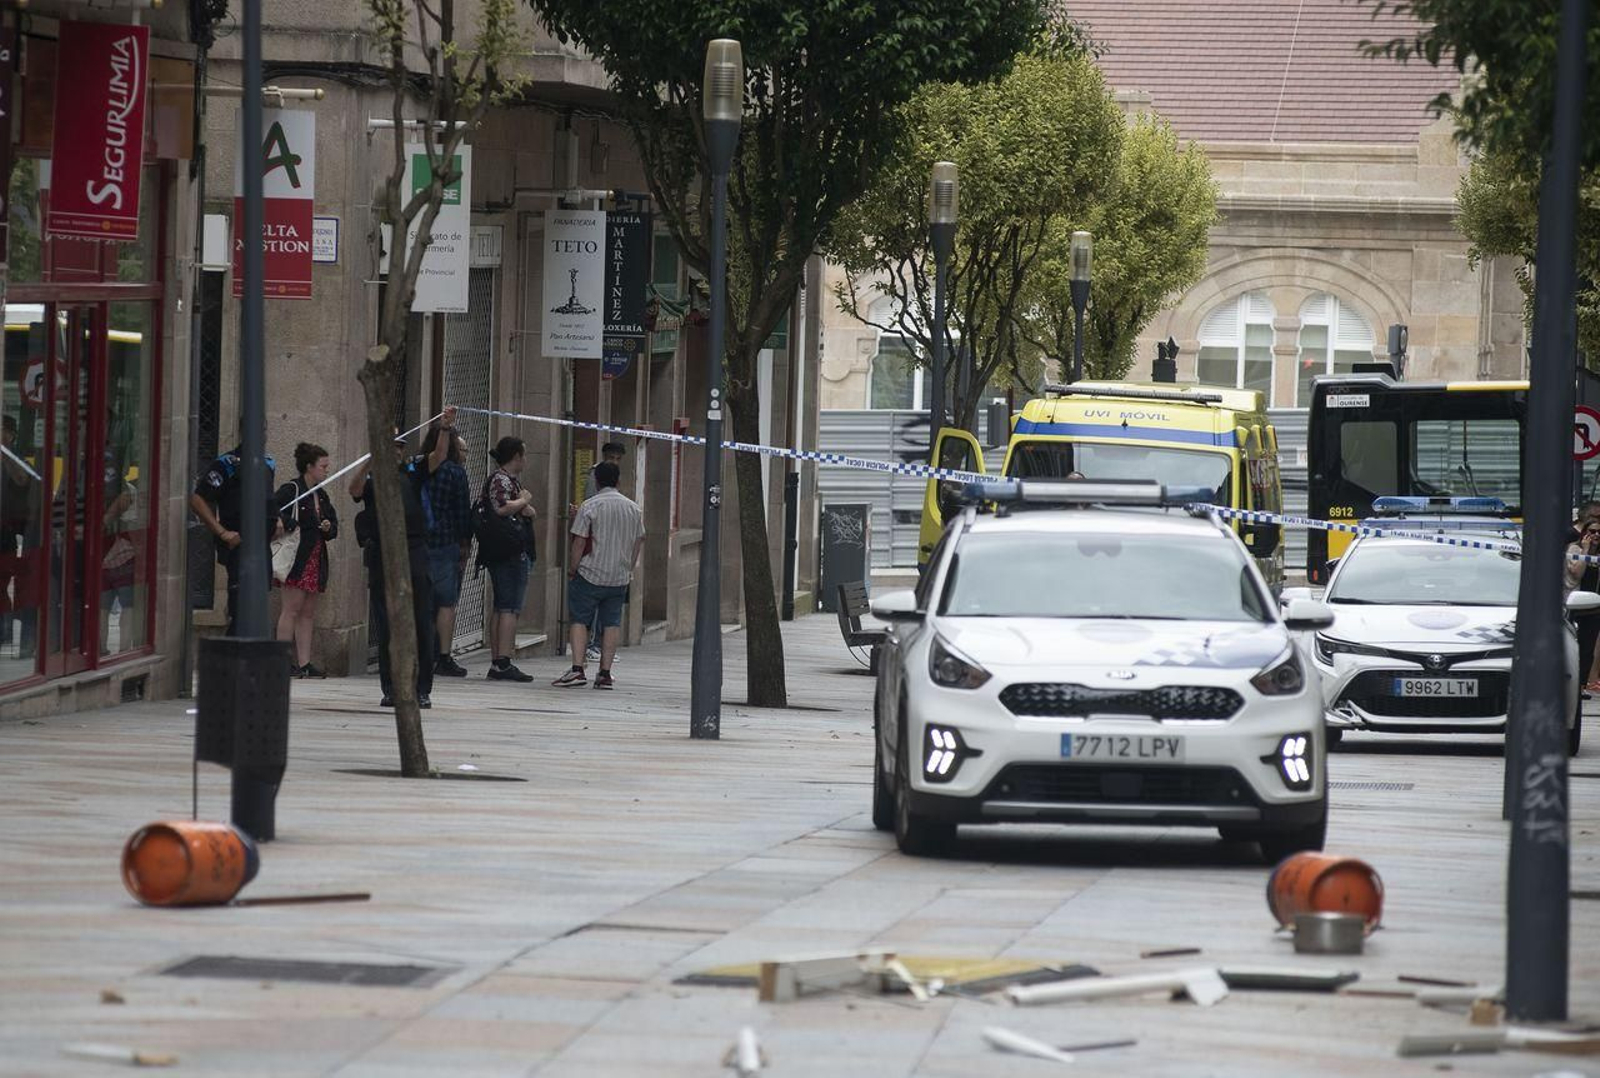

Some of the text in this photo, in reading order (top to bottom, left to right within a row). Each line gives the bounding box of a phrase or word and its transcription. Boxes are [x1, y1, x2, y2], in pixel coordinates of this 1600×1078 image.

[86, 35, 139, 210] SEGURLIMIA
[450, 231, 462, 241] de
[551, 240, 598, 254] TETO
[602, 324, 643, 332] LOXERÍA
[845, 458, 890, 471] POLICIA LOCAL
[954, 472, 974, 482] LOCAL
[1329, 506, 1353, 517] 6912
[1405, 681, 1475, 695] 9962 LTW
[1075, 735, 1180, 757] 7712 LPV
